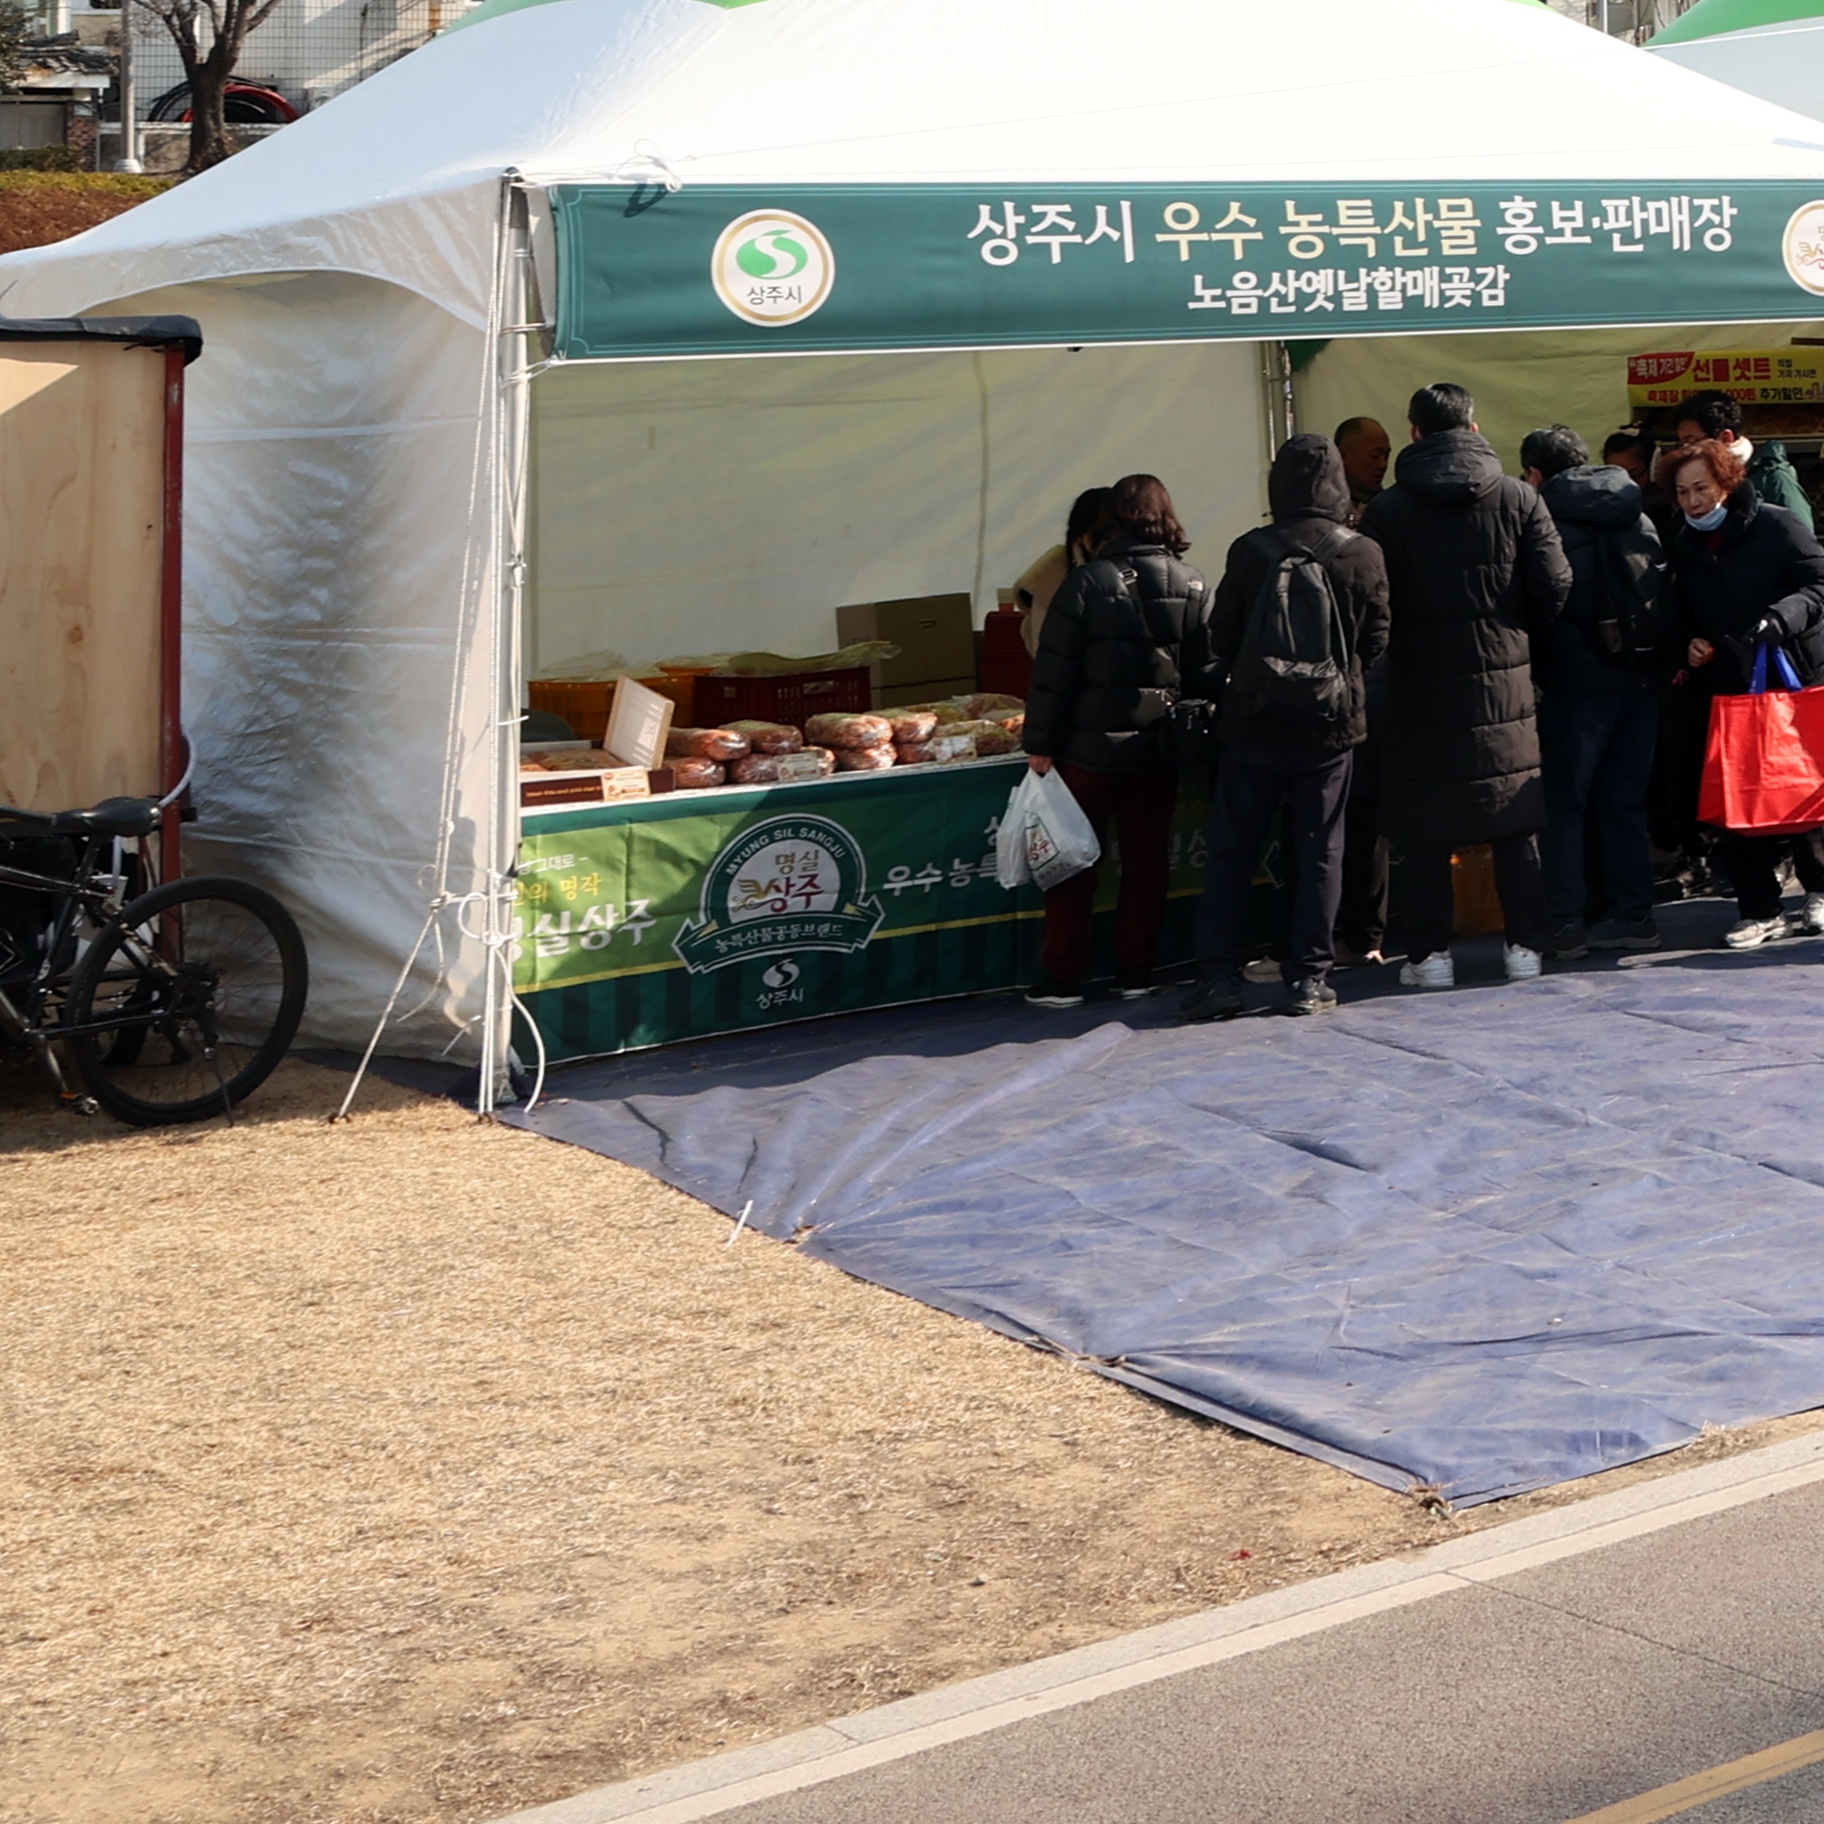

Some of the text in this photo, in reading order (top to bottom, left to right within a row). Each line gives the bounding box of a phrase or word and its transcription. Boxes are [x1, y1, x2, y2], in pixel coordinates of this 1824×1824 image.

[966, 200, 1134, 266] 상주시
[1155, 201, 1264, 262] 우수
[1278, 197, 1481, 259] 농특산물
[747, 285, 802, 305] 상주시
[1187, 264, 1510, 315] 노음산옛날할매곶감
[1733, 358, 1771, 381] 셋트
[535, 854, 576, 873] 그대로
[725, 827, 847, 875] MYUNG SIL SANGJU
[775, 849, 821, 875] 명실
[559, 872, 602, 901] 명작
[756, 873, 825, 913] 상주
[883, 862, 944, 896] 우수
[755, 988, 805, 1010] 상주시
